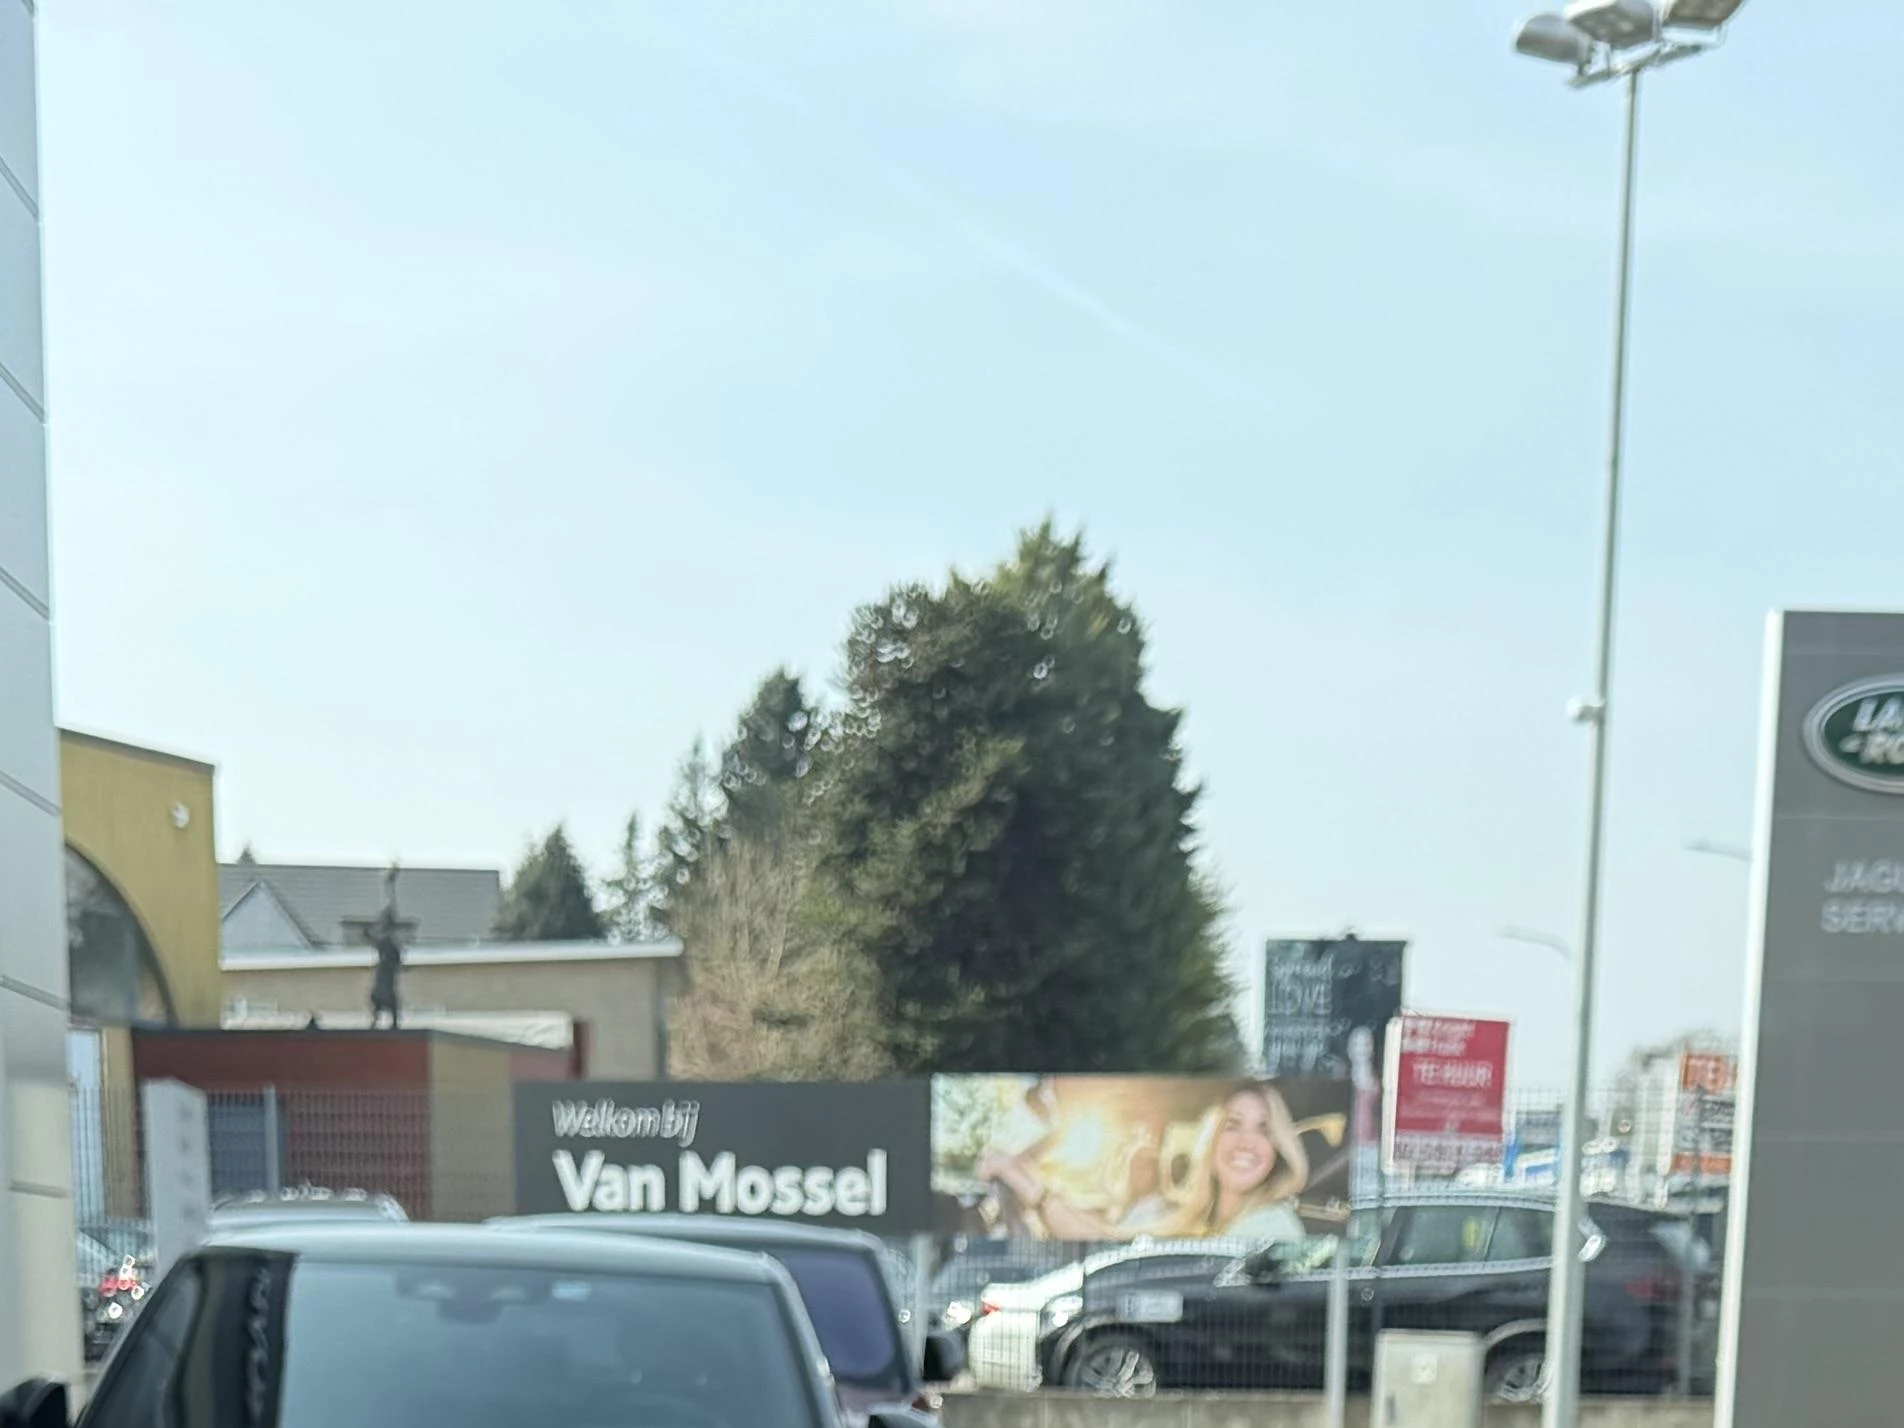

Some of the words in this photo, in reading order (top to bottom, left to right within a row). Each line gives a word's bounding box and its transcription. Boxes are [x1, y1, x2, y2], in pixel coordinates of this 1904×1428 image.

[552, 1100, 660, 1138] Welkom
[662, 1100, 700, 1147] bij
[552, 1150, 666, 1212] Van
[679, 1148, 888, 1216] Mossel
